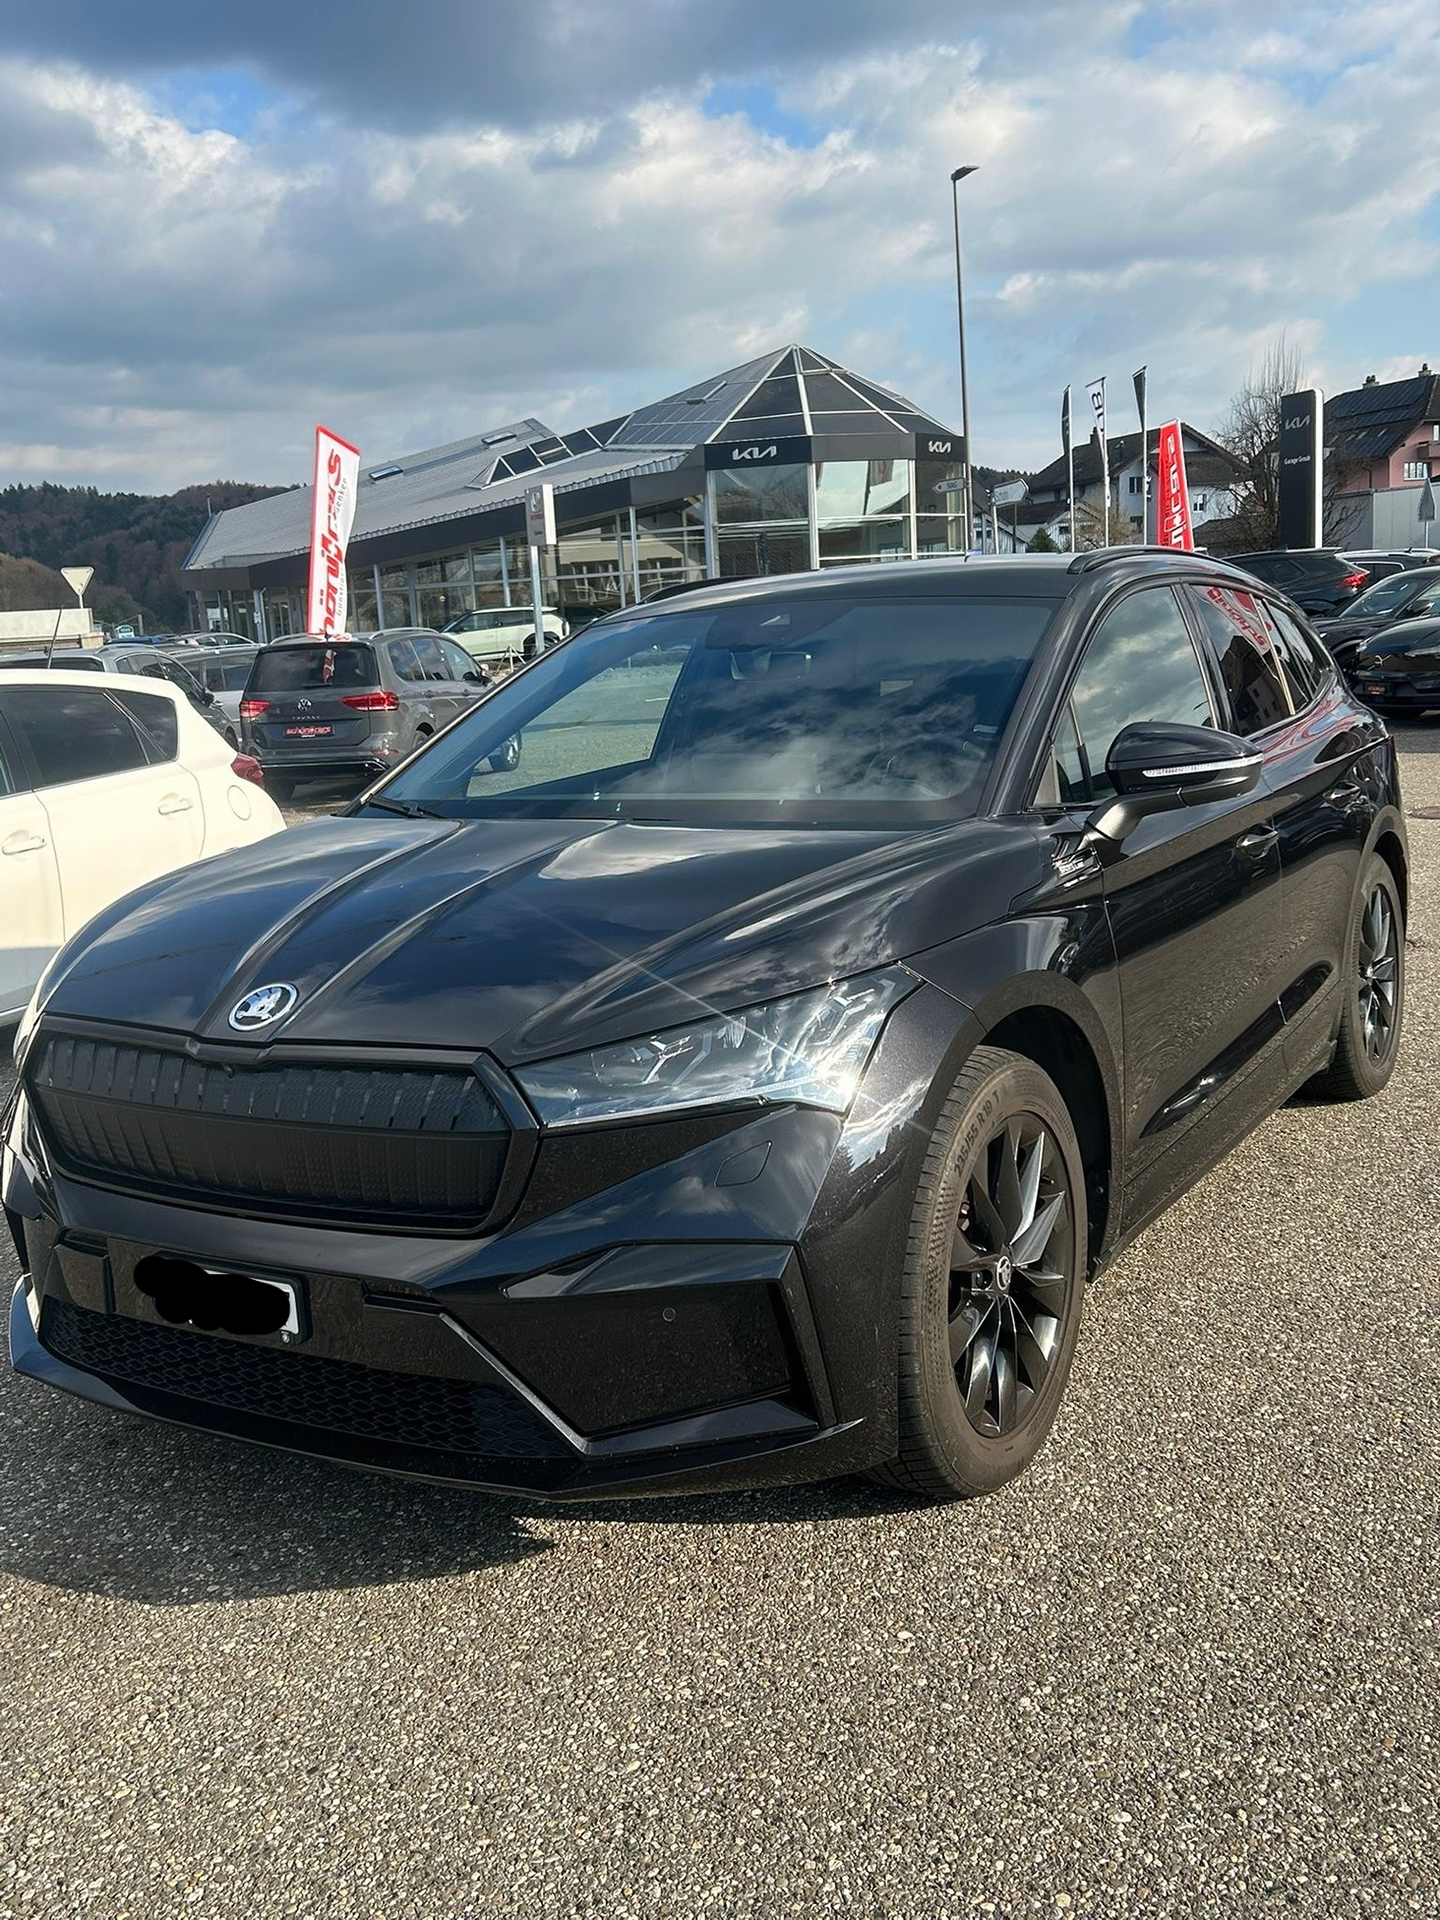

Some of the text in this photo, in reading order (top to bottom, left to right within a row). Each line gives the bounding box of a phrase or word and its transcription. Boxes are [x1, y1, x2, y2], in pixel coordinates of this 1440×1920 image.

[1285, 414, 1310, 430] KIA
[732, 445, 777, 460] KIA
[928, 441, 951, 453] KIA
